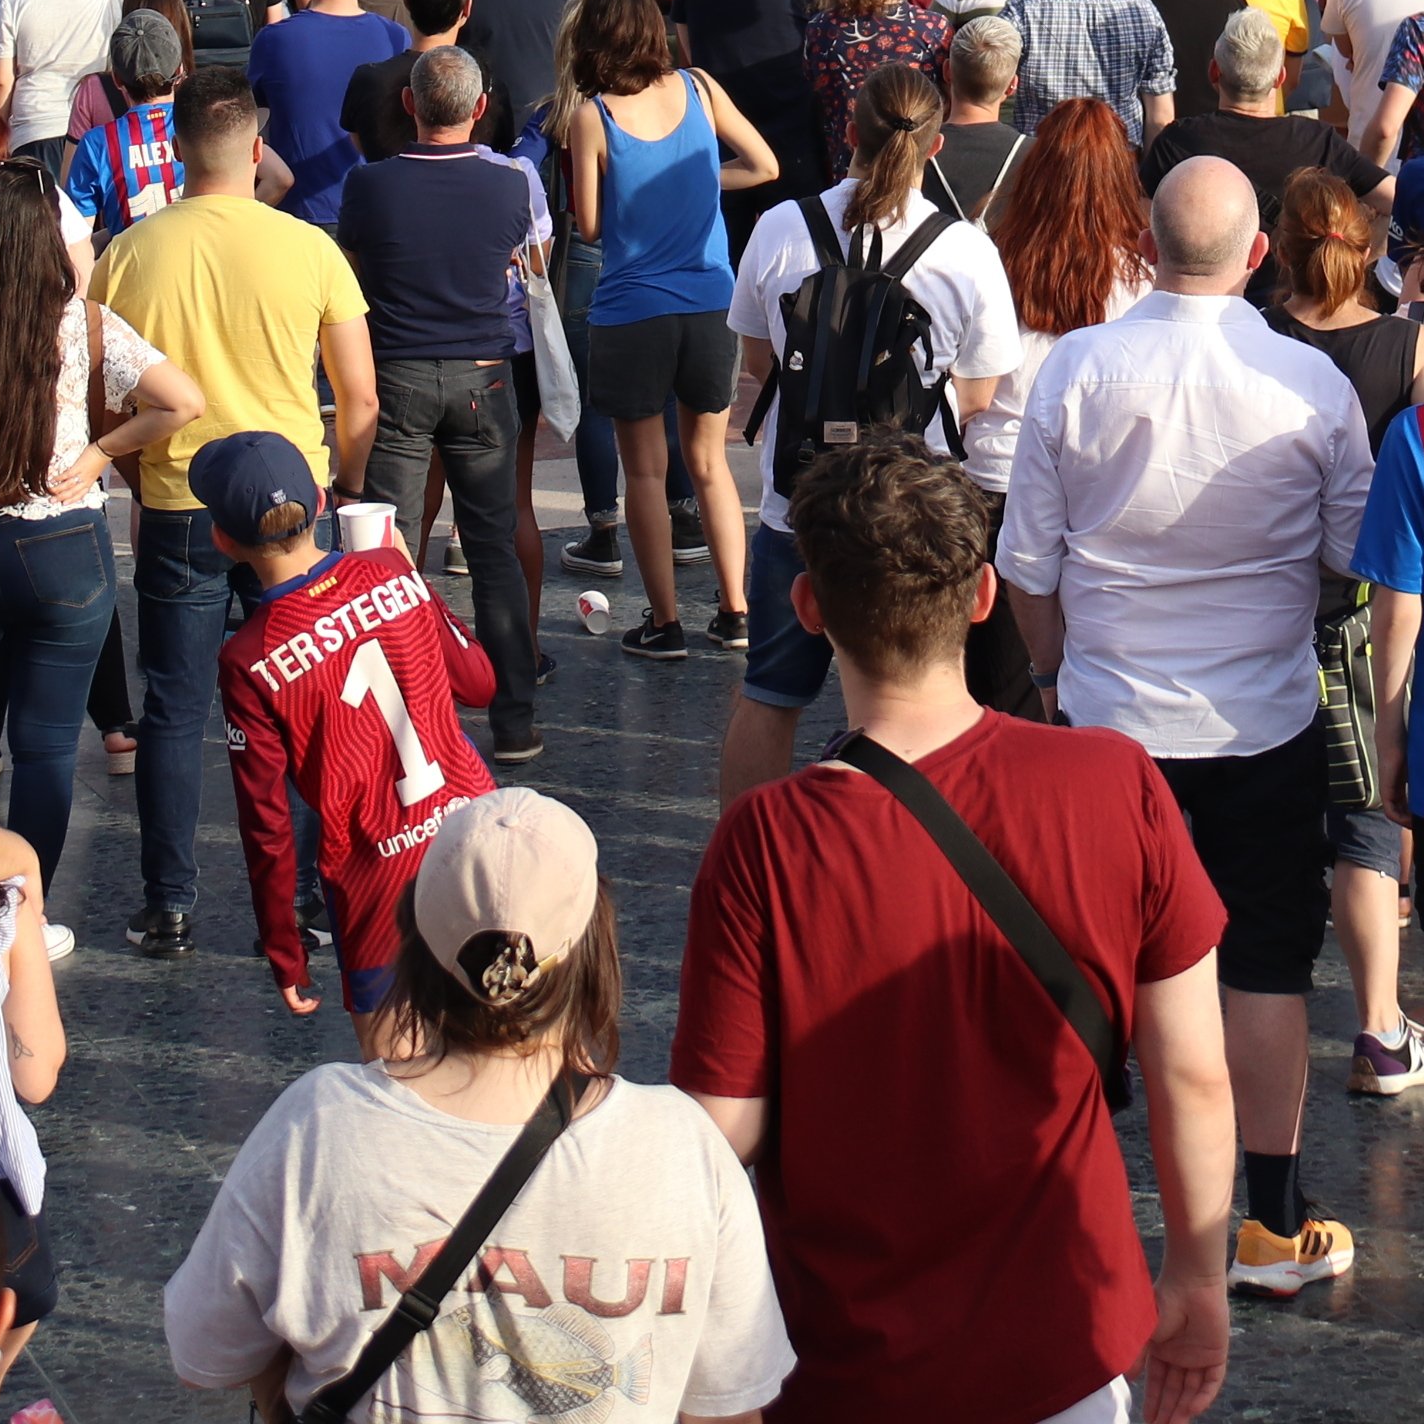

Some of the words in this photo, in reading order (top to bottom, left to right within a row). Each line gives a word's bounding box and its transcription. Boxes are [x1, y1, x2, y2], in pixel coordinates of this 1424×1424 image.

[250, 631, 325, 692] TER
[314, 570, 433, 653] STEGEN
[339, 637, 446, 808] 1
[377, 805, 446, 859] unicef
